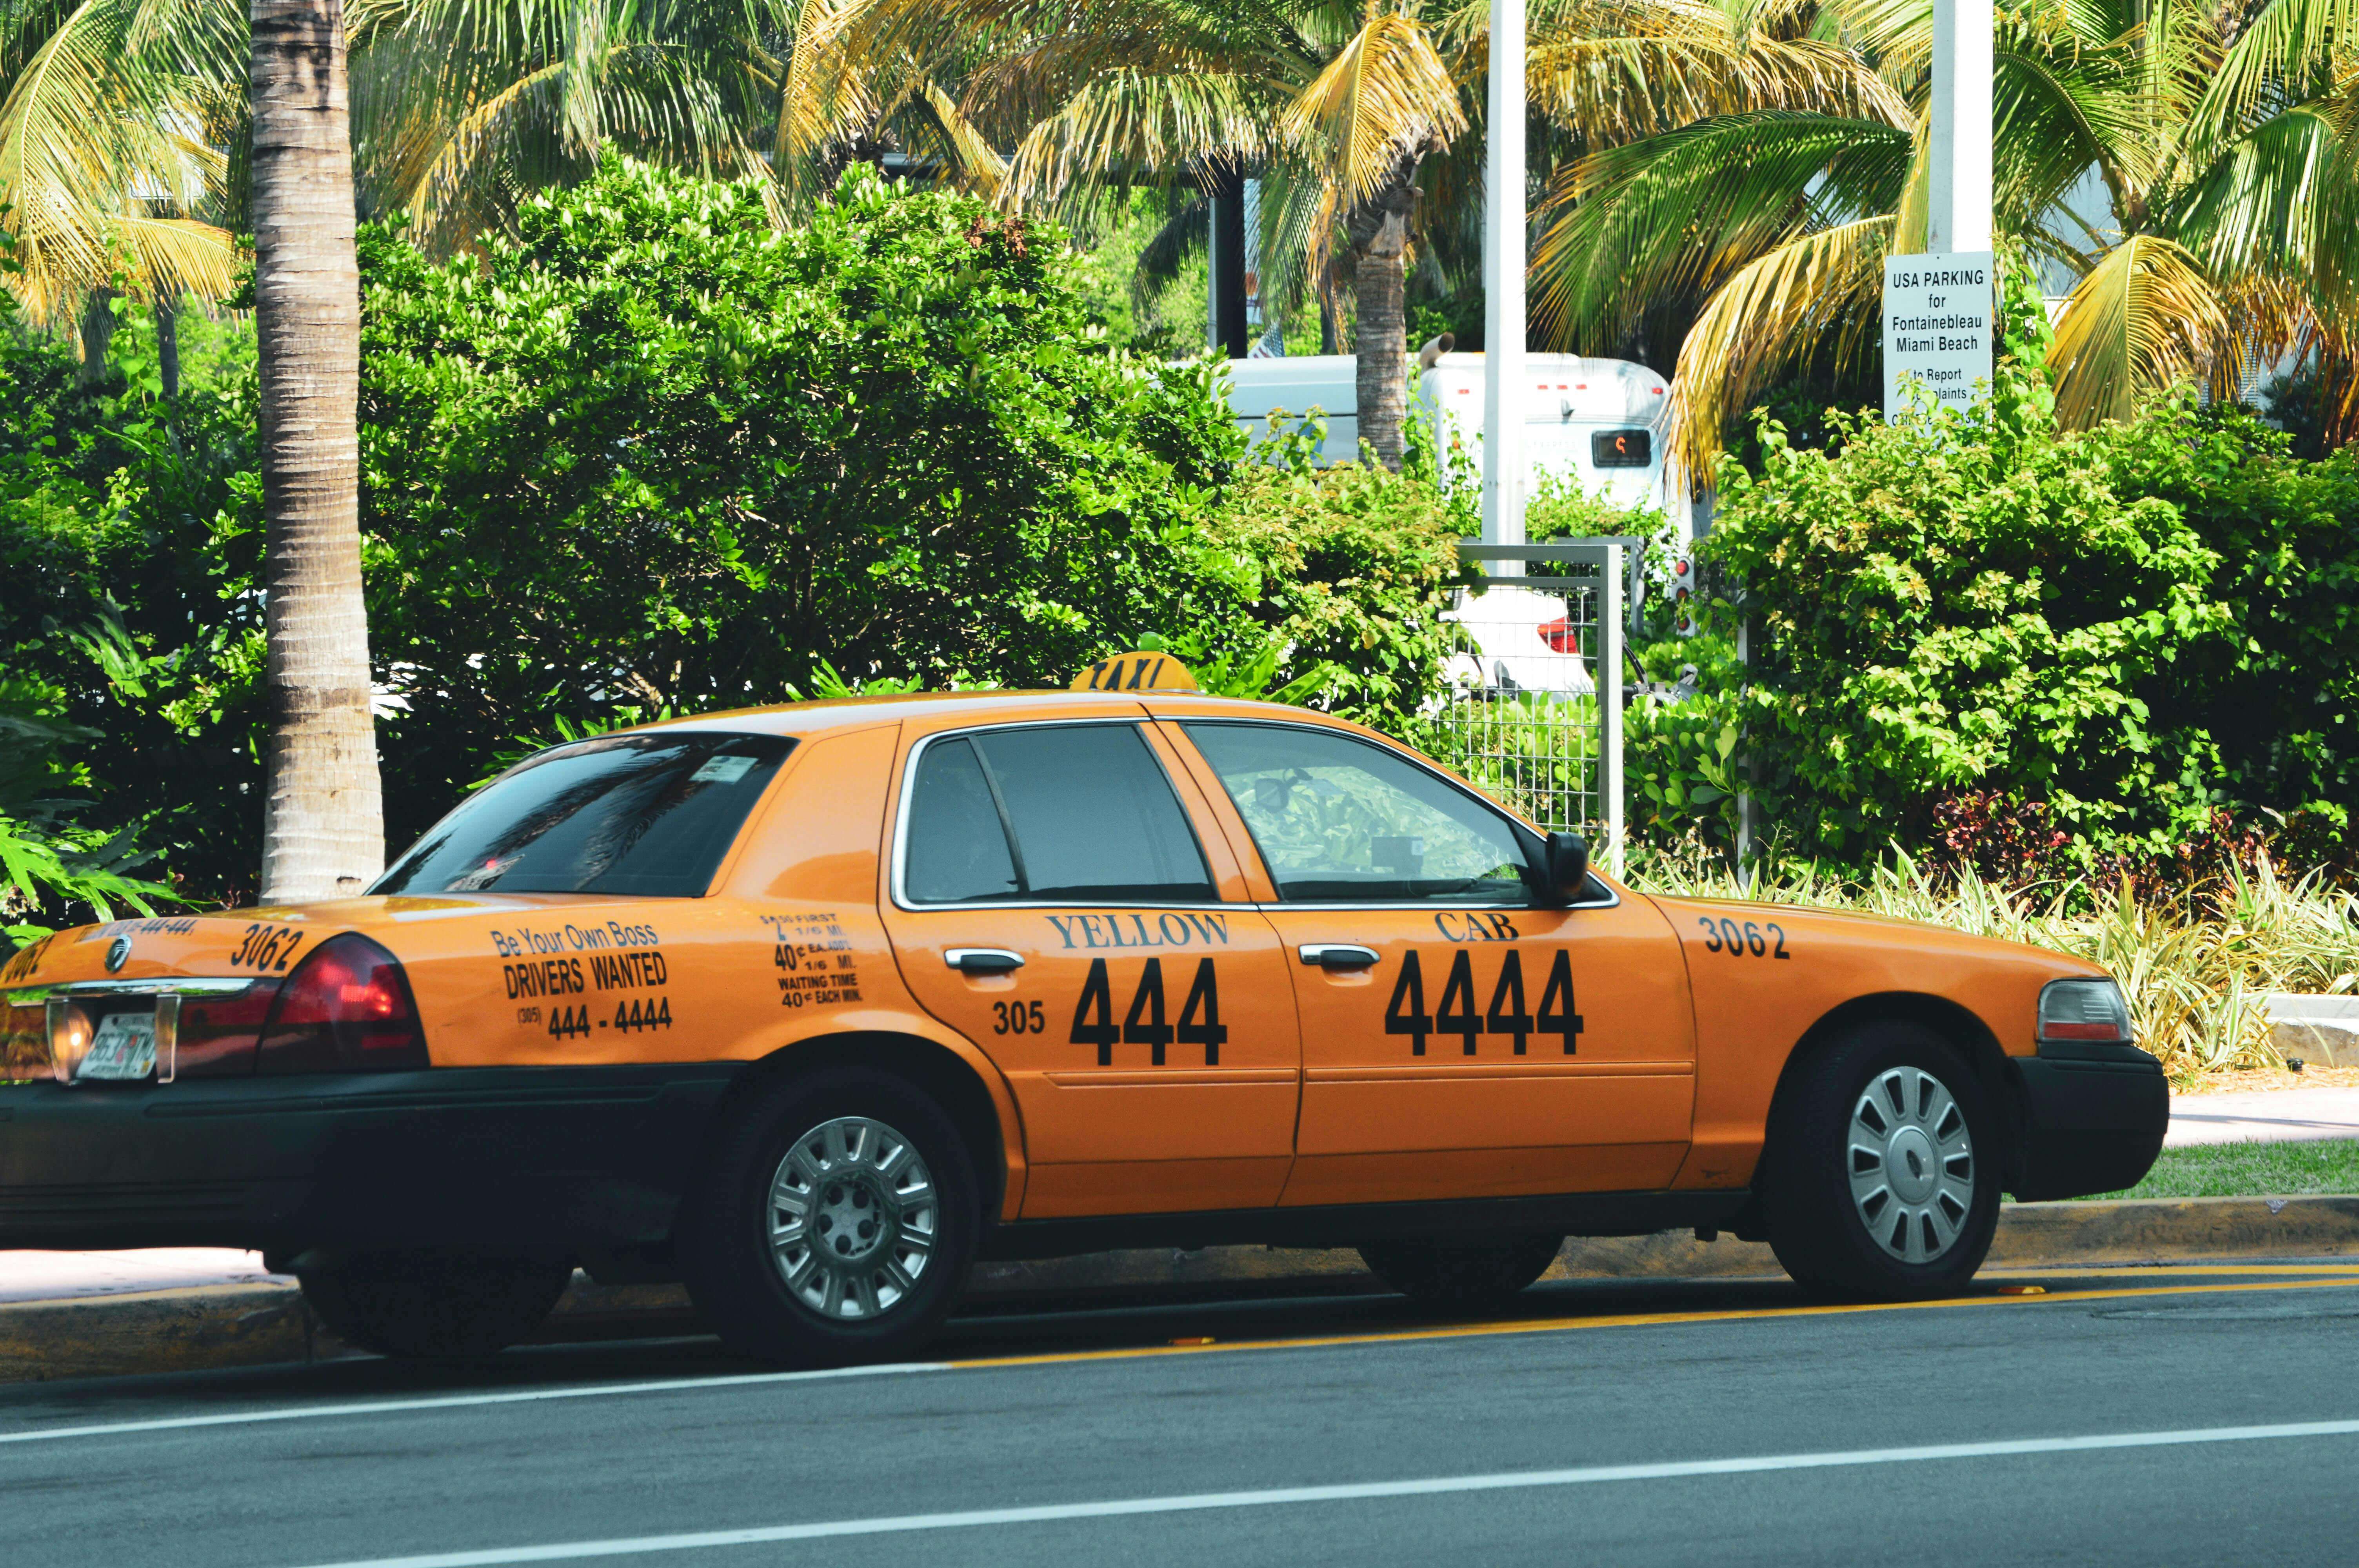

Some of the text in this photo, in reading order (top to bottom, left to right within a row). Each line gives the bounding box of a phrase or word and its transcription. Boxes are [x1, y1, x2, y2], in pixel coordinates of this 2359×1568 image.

[1893, 270, 1984, 288] USA PARKING
[1929, 294, 1946, 308] for
[1893, 315, 1982, 330] Fontainebleau
[1897, 335, 1977, 352] Miami Beach
[1928, 368, 1961, 383] Report
[1089, 658, 1165, 690] TAXI
[490, 921, 659, 958] Be Your Own Boss
[1044, 913, 1519, 949] YELLOW CAB
[1699, 916, 1790, 960] 3062
[231, 924, 304, 971] 3062
[503, 951, 667, 999] DRIVERS WANTED
[778, 973, 858, 991] WAITING TIME
[815, 990, 841, 1004] EACH
[842, 989, 863, 1002] MIN.
[992, 949, 1584, 1065] 305 444 4444
[517, 1005, 542, 1027] (305)
[549, 1004, 591, 1041] 444
[614, 997, 672, 1034] 4444
